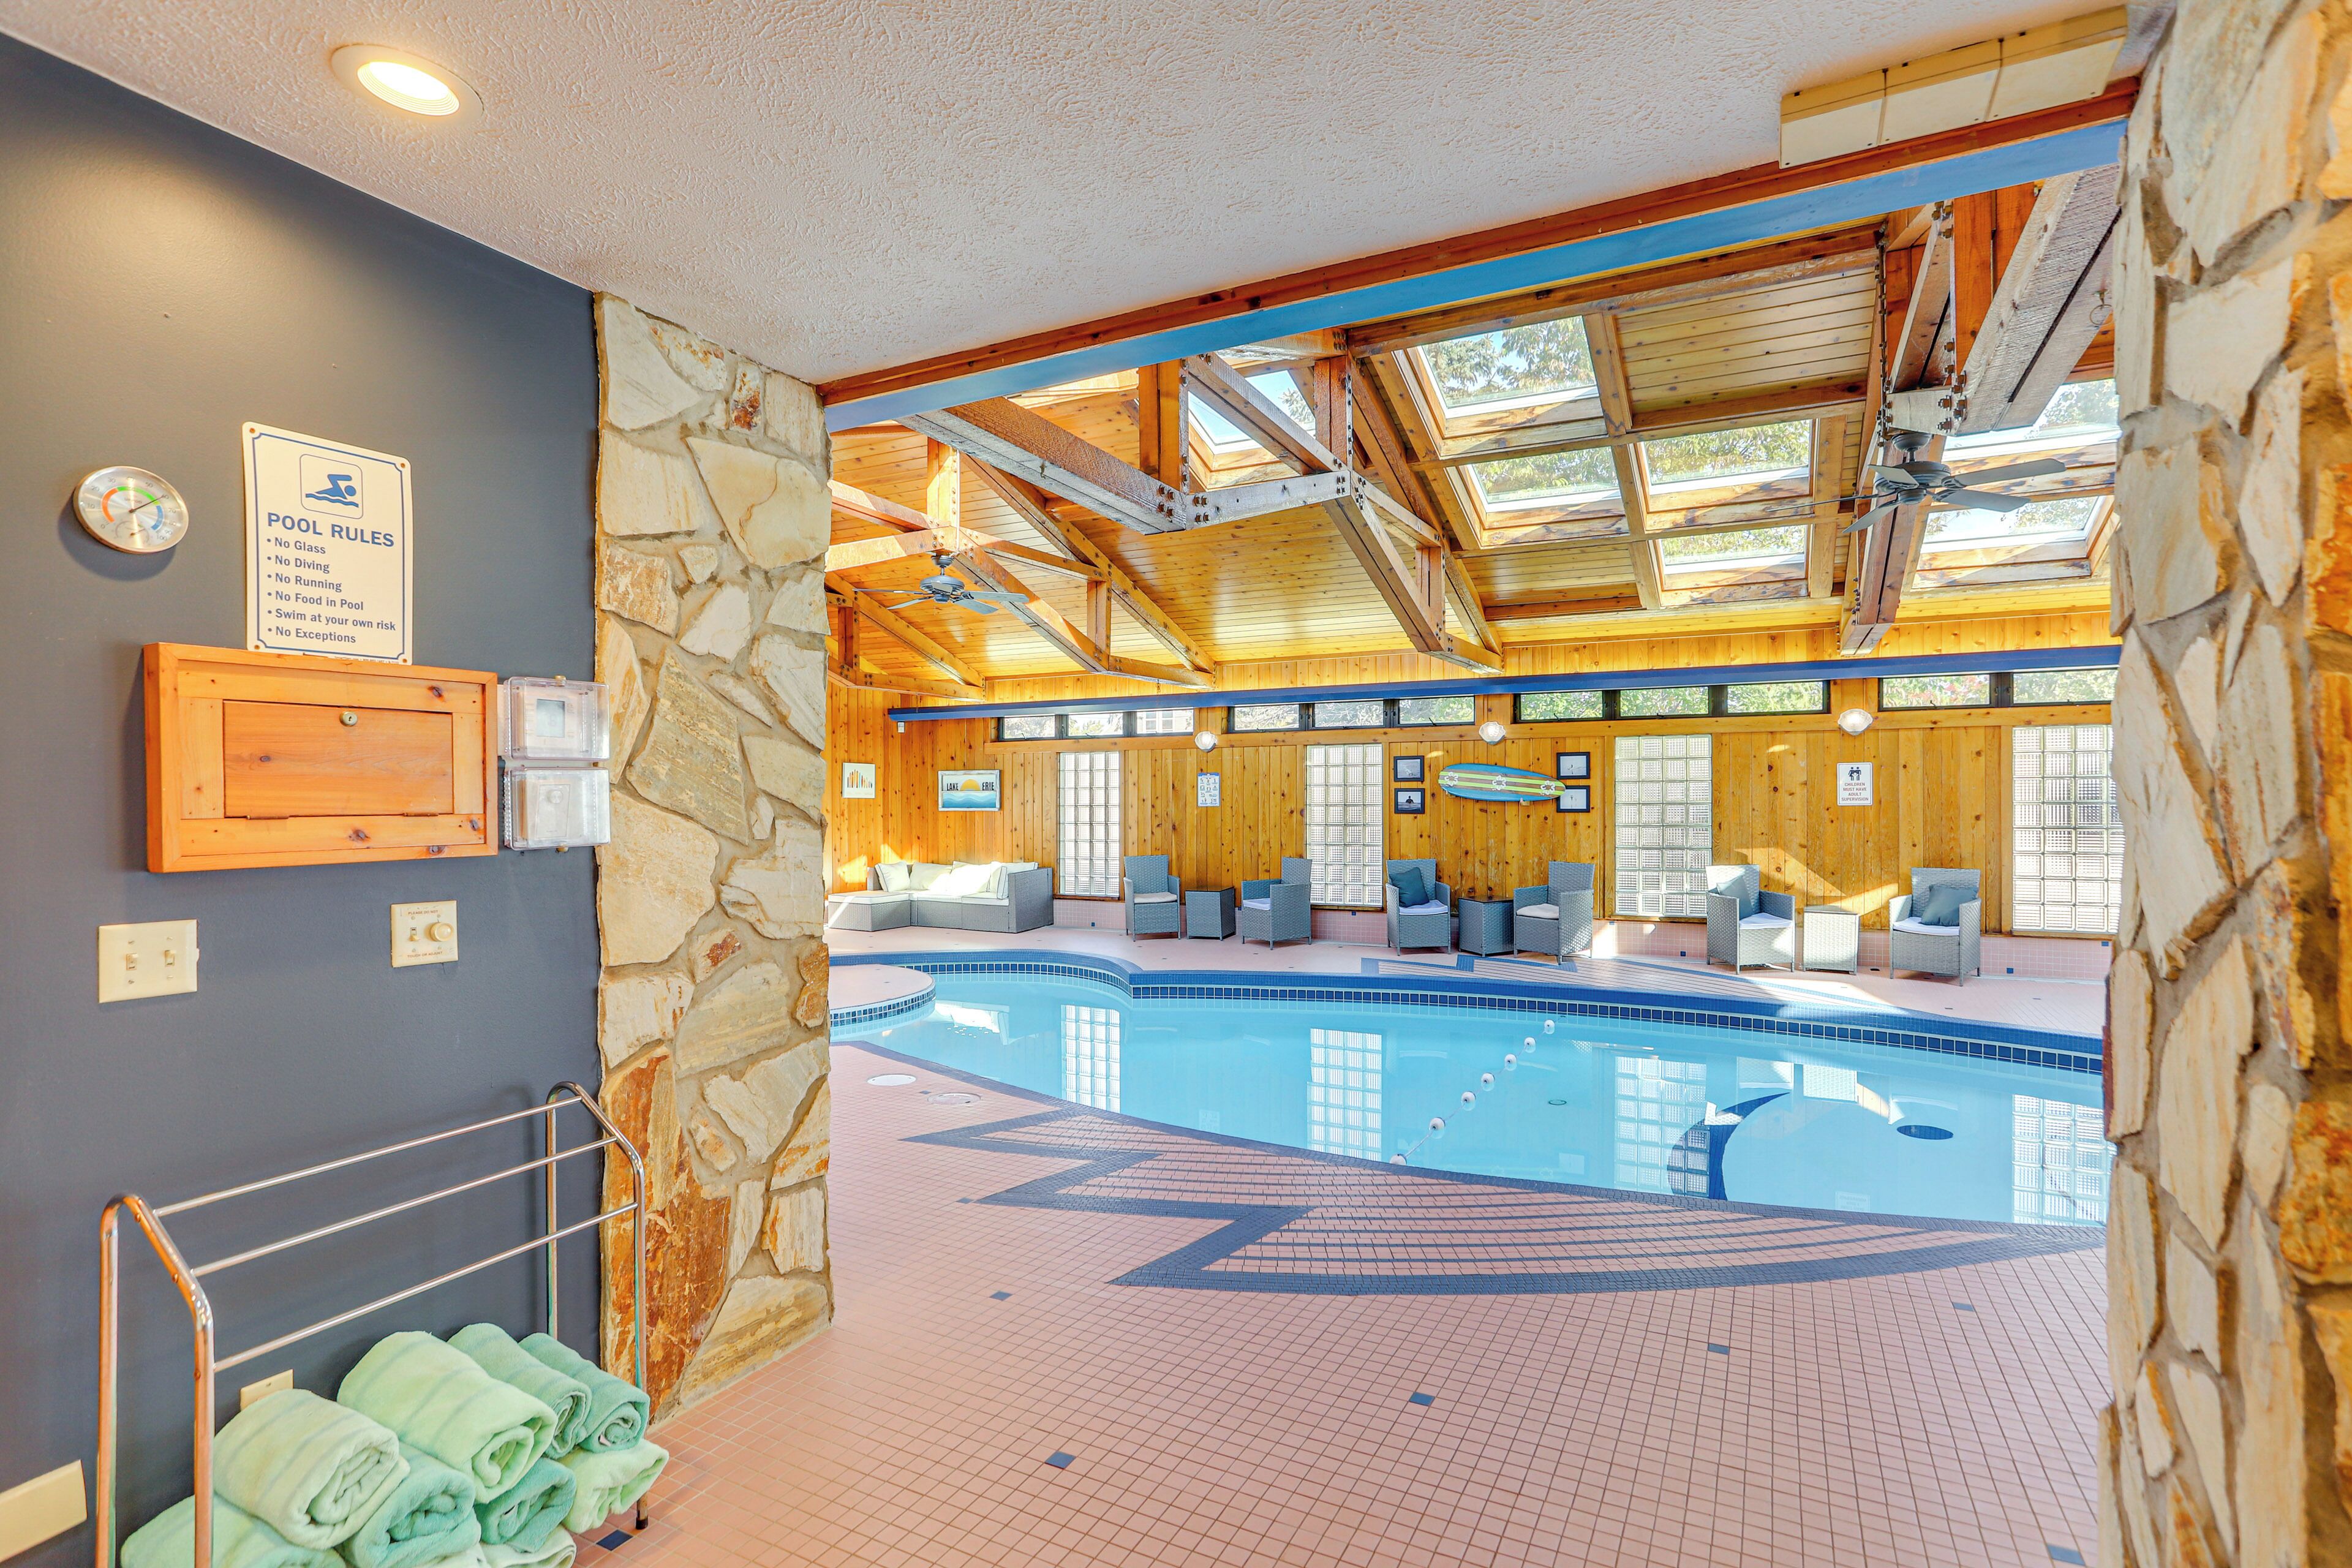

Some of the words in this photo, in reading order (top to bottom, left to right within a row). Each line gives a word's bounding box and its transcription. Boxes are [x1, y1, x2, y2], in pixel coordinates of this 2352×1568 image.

[268, 512, 323, 536] POOL
[331, 524, 395, 548] RULES
[274, 537, 290, 549] No
[294, 540, 326, 554] Glass
[275, 554, 290, 567] No
[295, 557, 330, 574] Diving
[275, 572, 291, 584] No
[295, 575, 342, 593] Running
[276, 590, 291, 601] No
[295, 593, 322, 606] Food
[326, 597, 336, 608] in
[341, 598, 363, 611] Pool
[275, 608, 306, 621] Swim
[311, 613, 322, 623] at
[325, 616, 350, 627] your
[352, 619, 373, 628] own
[377, 620, 396, 631] risk
[276, 626, 291, 637] No
[295, 628, 356, 644] Exceptions
[946, 783, 959, 791] LAKE
[982, 782, 995, 791] ERIE
